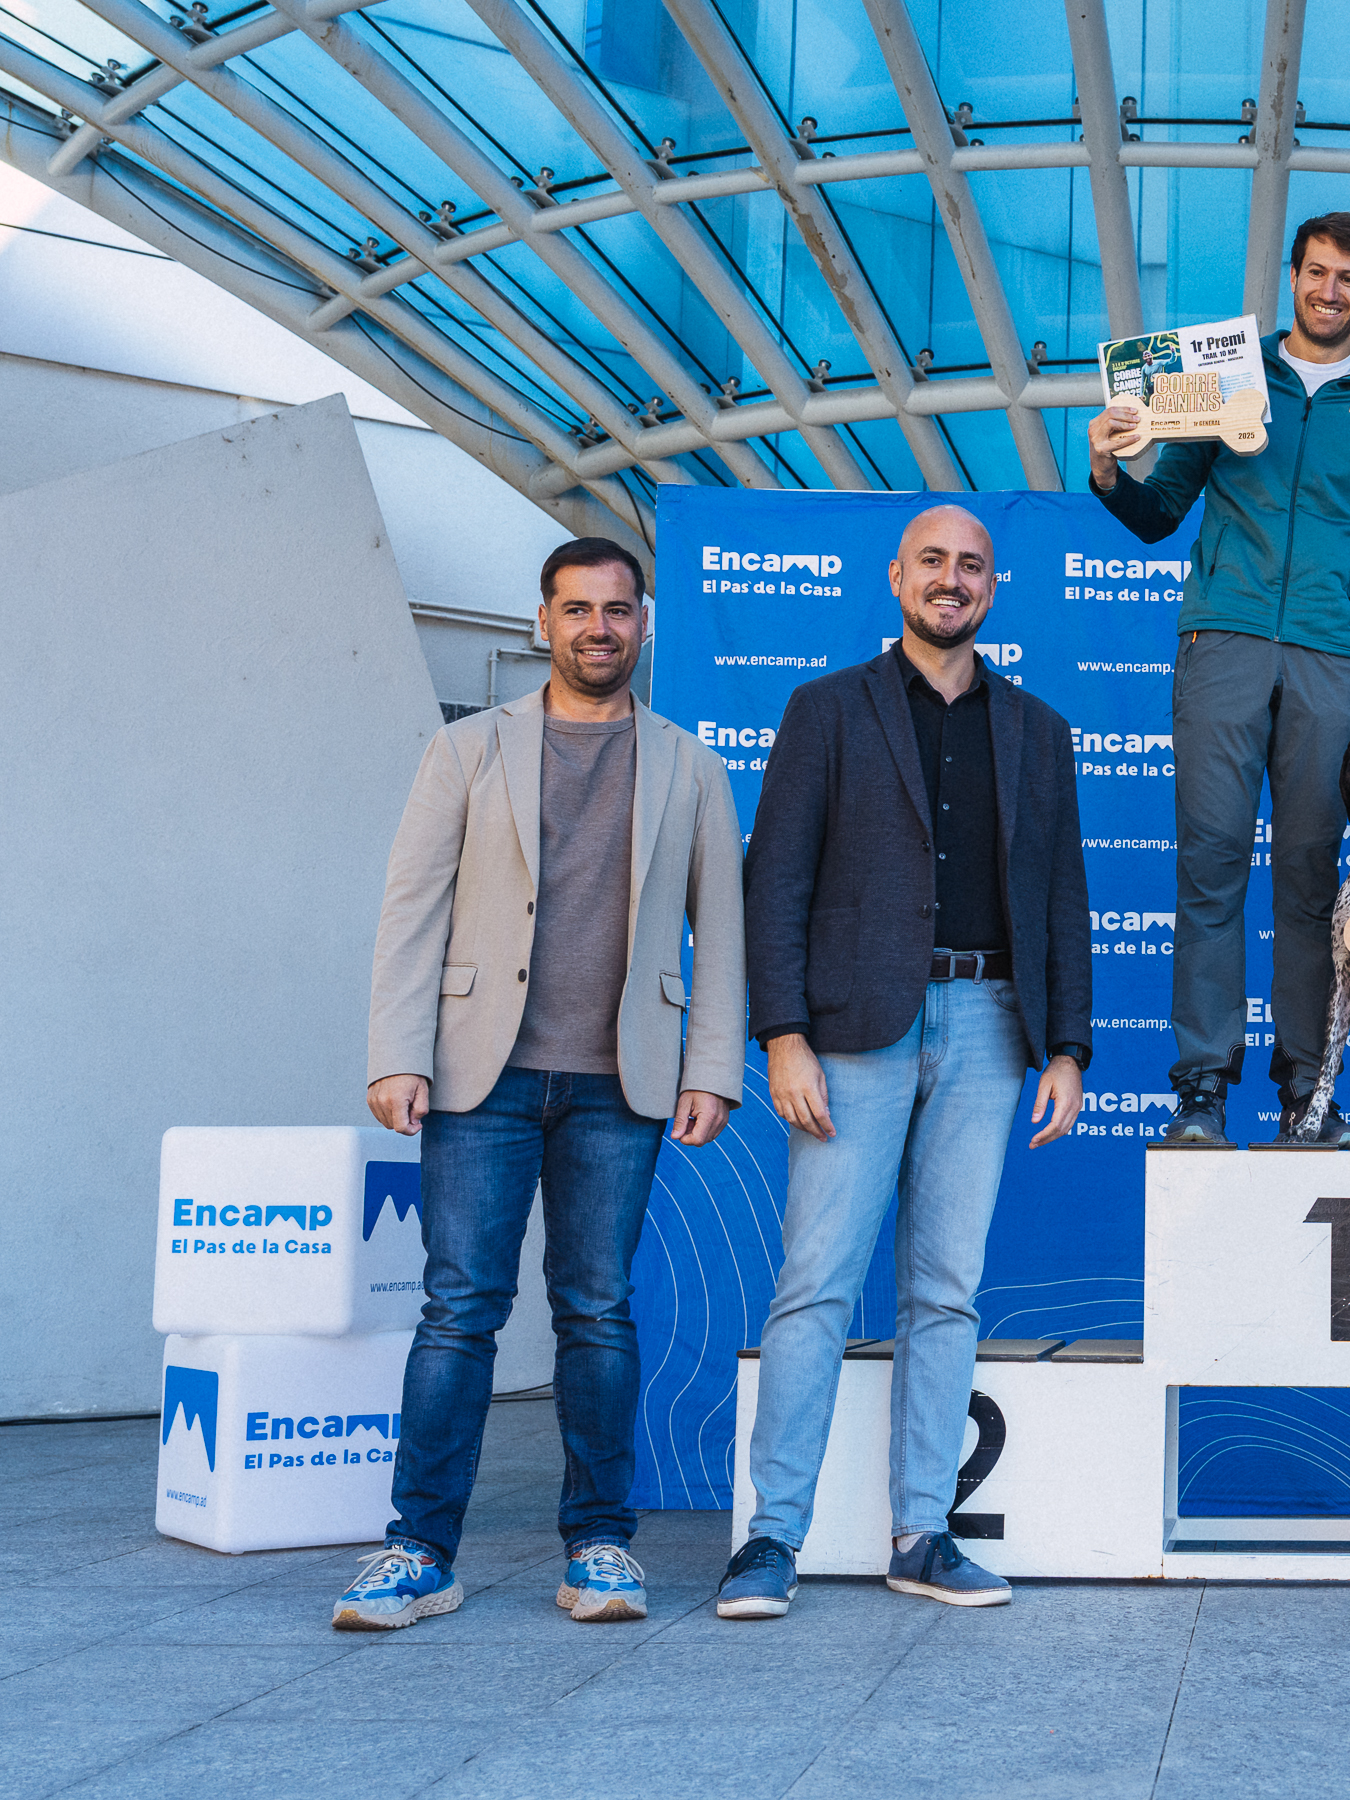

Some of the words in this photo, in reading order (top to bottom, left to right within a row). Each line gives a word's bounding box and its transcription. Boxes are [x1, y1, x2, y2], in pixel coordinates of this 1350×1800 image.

[1190, 340, 1202, 353] 1r
[1206, 331, 1246, 350] Premi
[1202, 352, 1218, 360] TRAIL
[1113, 368, 1141, 381] CORRE
[1155, 373, 1217, 394] CORRE
[1151, 392, 1221, 414] CANINS
[1238, 432, 1255, 440] 2025
[702, 546, 842, 577] Encamp
[702, 579, 716, 593] El
[720, 580, 749, 594] Pas
[753, 581, 776, 594] de
[780, 581, 796, 595] la
[799, 582, 842, 597] Casa
[1065, 587, 1080, 600] El
[1084, 587, 1113, 601] Pas
[1118, 588, 1139, 601] de
[1144, 588, 1159, 602] la
[1163, 589, 1184, 602] Ca
[714, 655, 827, 669] www.encamp.ad
[1077, 661, 1175, 675] www.encamp.
[697, 721, 777, 747] Enca
[1070, 728, 1174, 753] Encam
[1082, 762, 1111, 775] Pas
[1116, 763, 1138, 776] de
[1143, 763, 1158, 776] la
[1081, 838, 1178, 851] ww.encamp.
[1091, 943, 1109, 954] as
[1113, 942, 1136, 954] de
[1141, 941, 1157, 954] la
[1245, 1033, 1259, 1046] El
[1082, 1092, 1180, 1116] ncam
[1077, 1123, 1106, 1135] Pas
[1111, 1123, 1134, 1136] de
[1139, 1123, 1154, 1136] la
[173, 1198, 333, 1231] Encamp
[171, 1239, 188, 1254] El
[193, 1239, 226, 1254] Pas
[232, 1239, 256, 1254] de
[263, 1239, 279, 1254] la
[284, 1239, 332, 1254] Casa
[244, 1453, 262, 1469] El
[269, 1453, 304, 1468] Pas
[310, 1451, 337, 1466] de
[343, 1449, 361, 1464] la
[366, 1448, 397, 1463] Ca
[945, 1388, 1006, 1540] 2
[166, 1488, 207, 1508] www.encamp.ad
